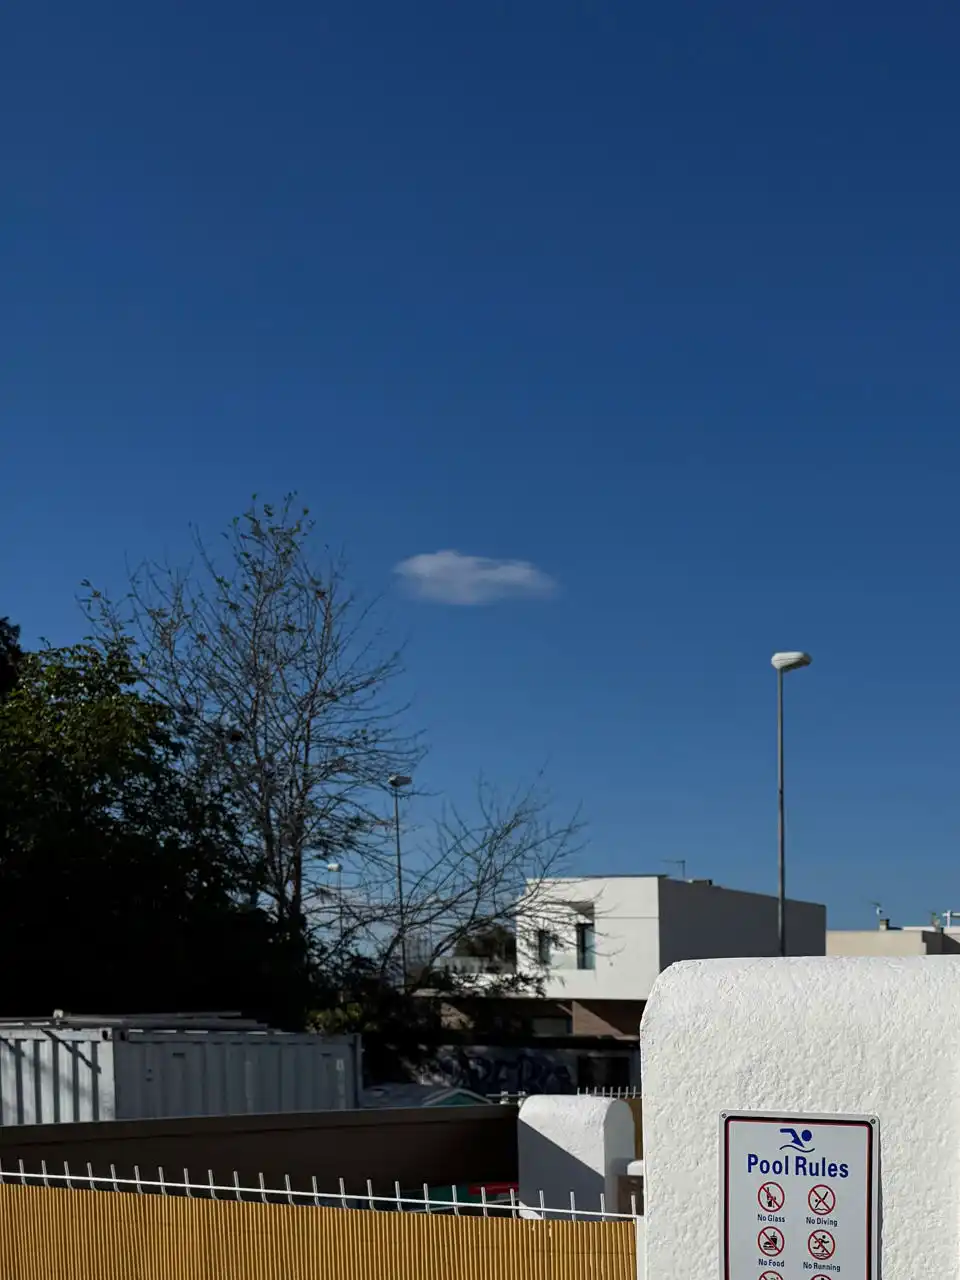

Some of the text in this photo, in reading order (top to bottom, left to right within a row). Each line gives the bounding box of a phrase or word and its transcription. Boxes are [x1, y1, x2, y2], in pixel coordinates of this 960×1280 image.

[747, 1153, 849, 1178] Pool Rules
[757, 1214, 786, 1223] No Glass
[806, 1217, 838, 1228] No Diving
[758, 1258, 785, 1268] No Food
[803, 1261, 841, 1273] No Running
